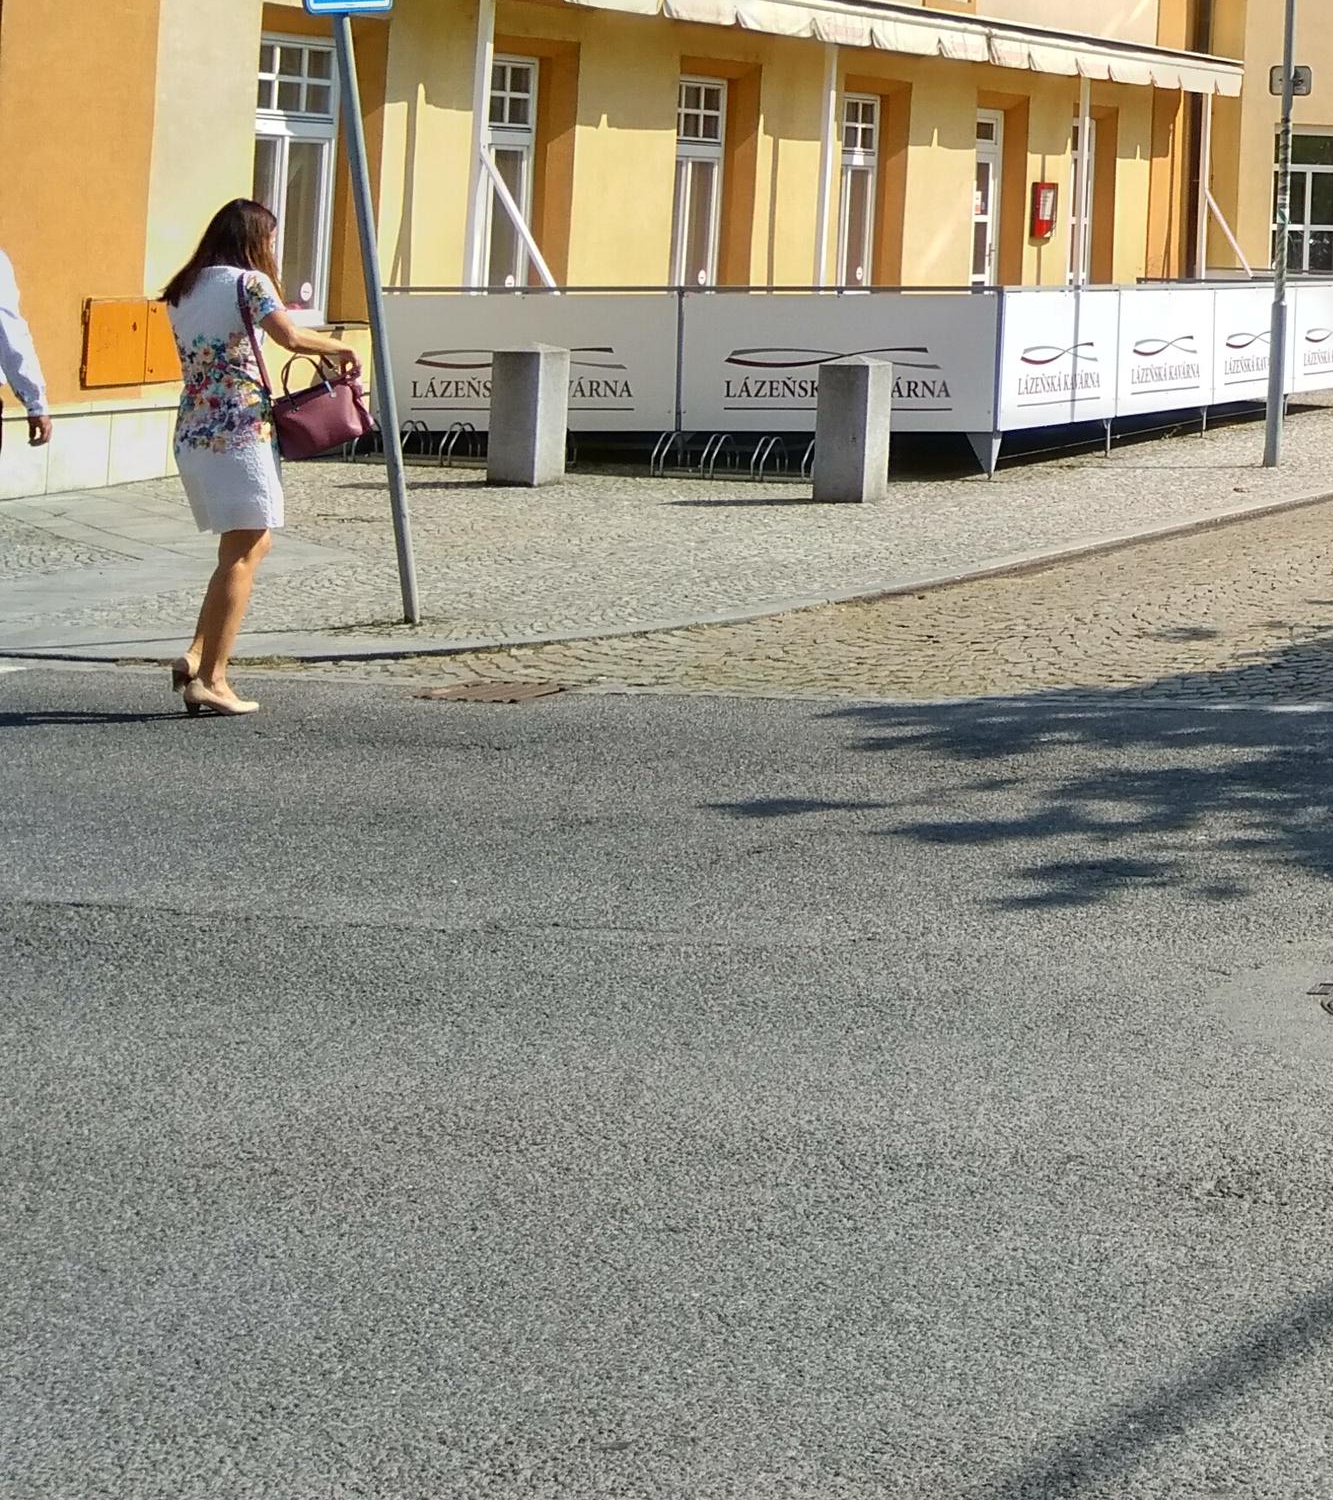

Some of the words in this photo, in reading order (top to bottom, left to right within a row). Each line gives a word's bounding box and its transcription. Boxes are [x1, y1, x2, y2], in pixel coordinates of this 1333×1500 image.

[1018, 370, 1062, 396] LÁZEŇSKÁ
[1063, 369, 1101, 392] KAVÁRNA
[1131, 363, 1168, 385] LÁZEŇSKÁ
[411, 377, 492, 398] LÁZEŇS
[569, 376, 634, 398] ÁRNA
[724, 376, 818, 398] LÁZEŇSK
[891, 376, 951, 398] ÁRNA
